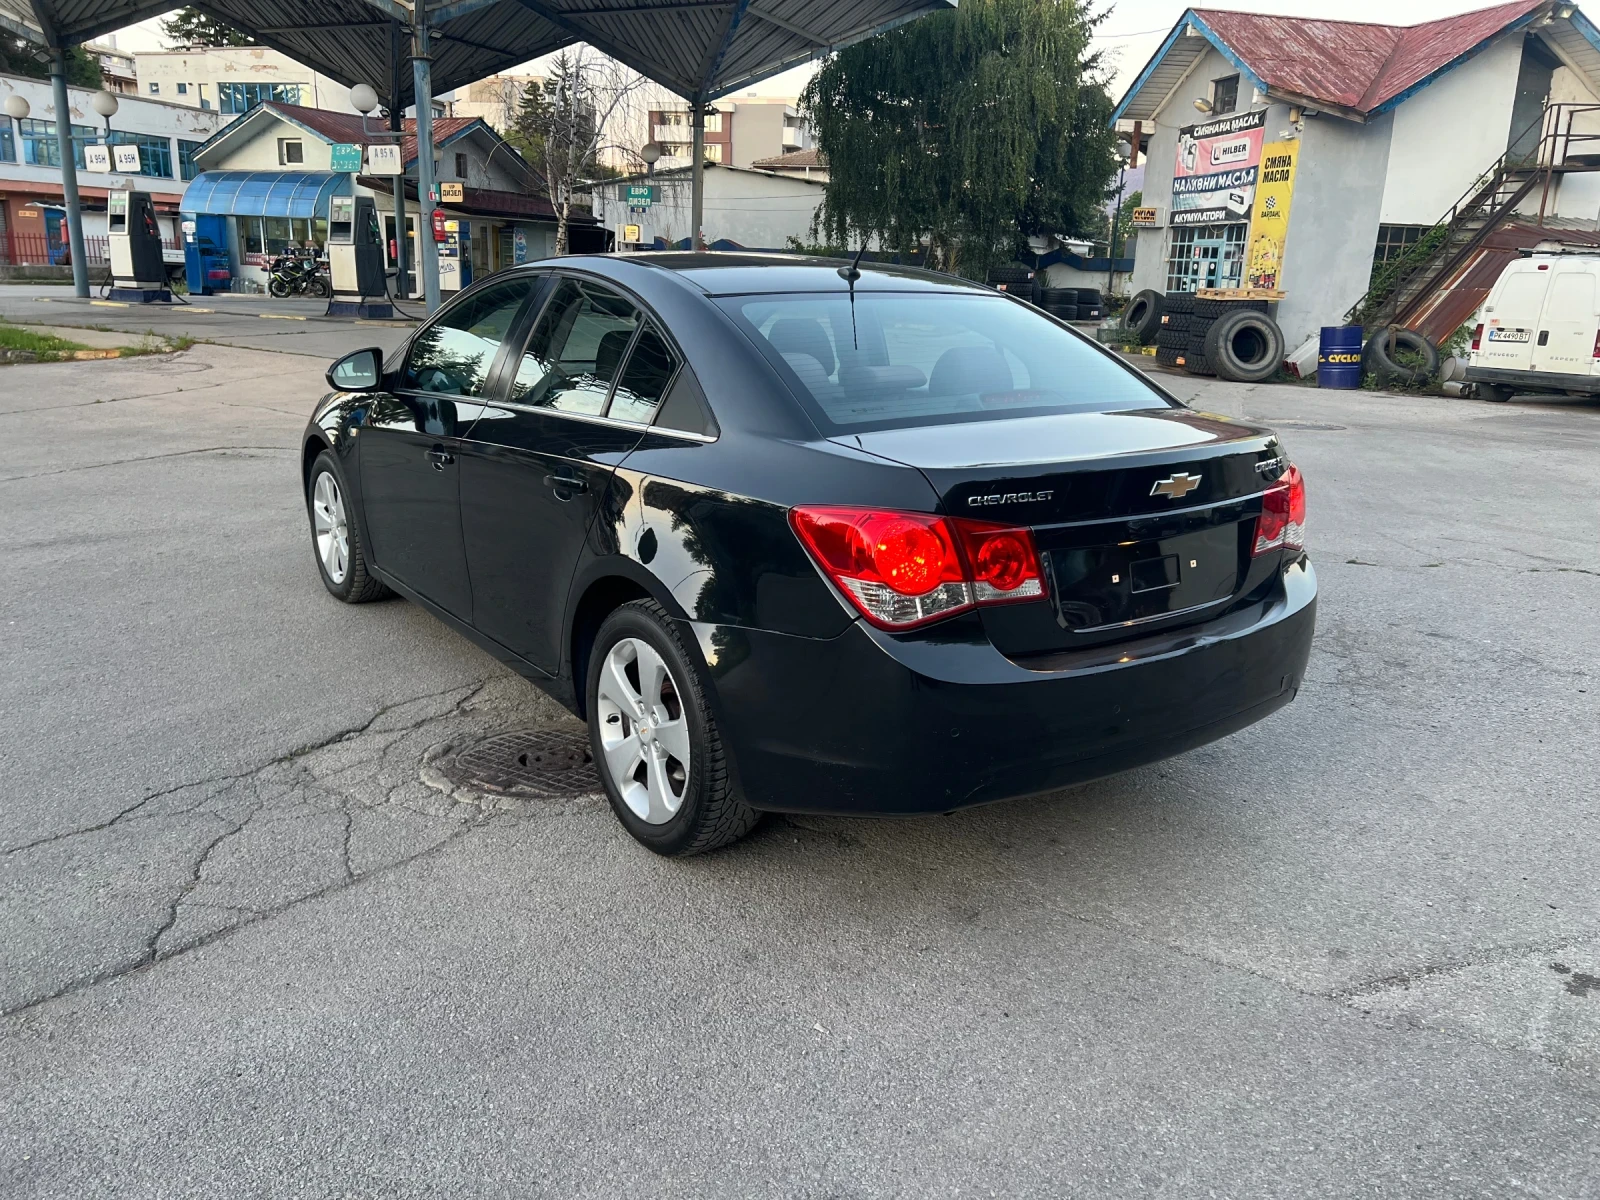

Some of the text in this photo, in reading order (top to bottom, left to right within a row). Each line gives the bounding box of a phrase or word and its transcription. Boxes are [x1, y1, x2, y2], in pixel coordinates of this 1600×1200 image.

[1193, 114, 1259, 137] СМЯНА НА МАСЛА
[1222, 144, 1247, 155] HILBER
[1264, 155, 1292, 170] СМЯНА
[1173, 168, 1255, 193] НАЛИВНИ МАСЛА
[1262, 169, 1290, 183] МАСЛА
[442, 189, 462, 197] ДИЗЕЛ
[628, 198, 651, 206] ДИЗЕЛ
[1174, 211, 1226, 223] АКУМУЛАТОРИ
[1503, 332, 1518, 340] 4490
[968, 490, 1054, 507] CHEVROLET
